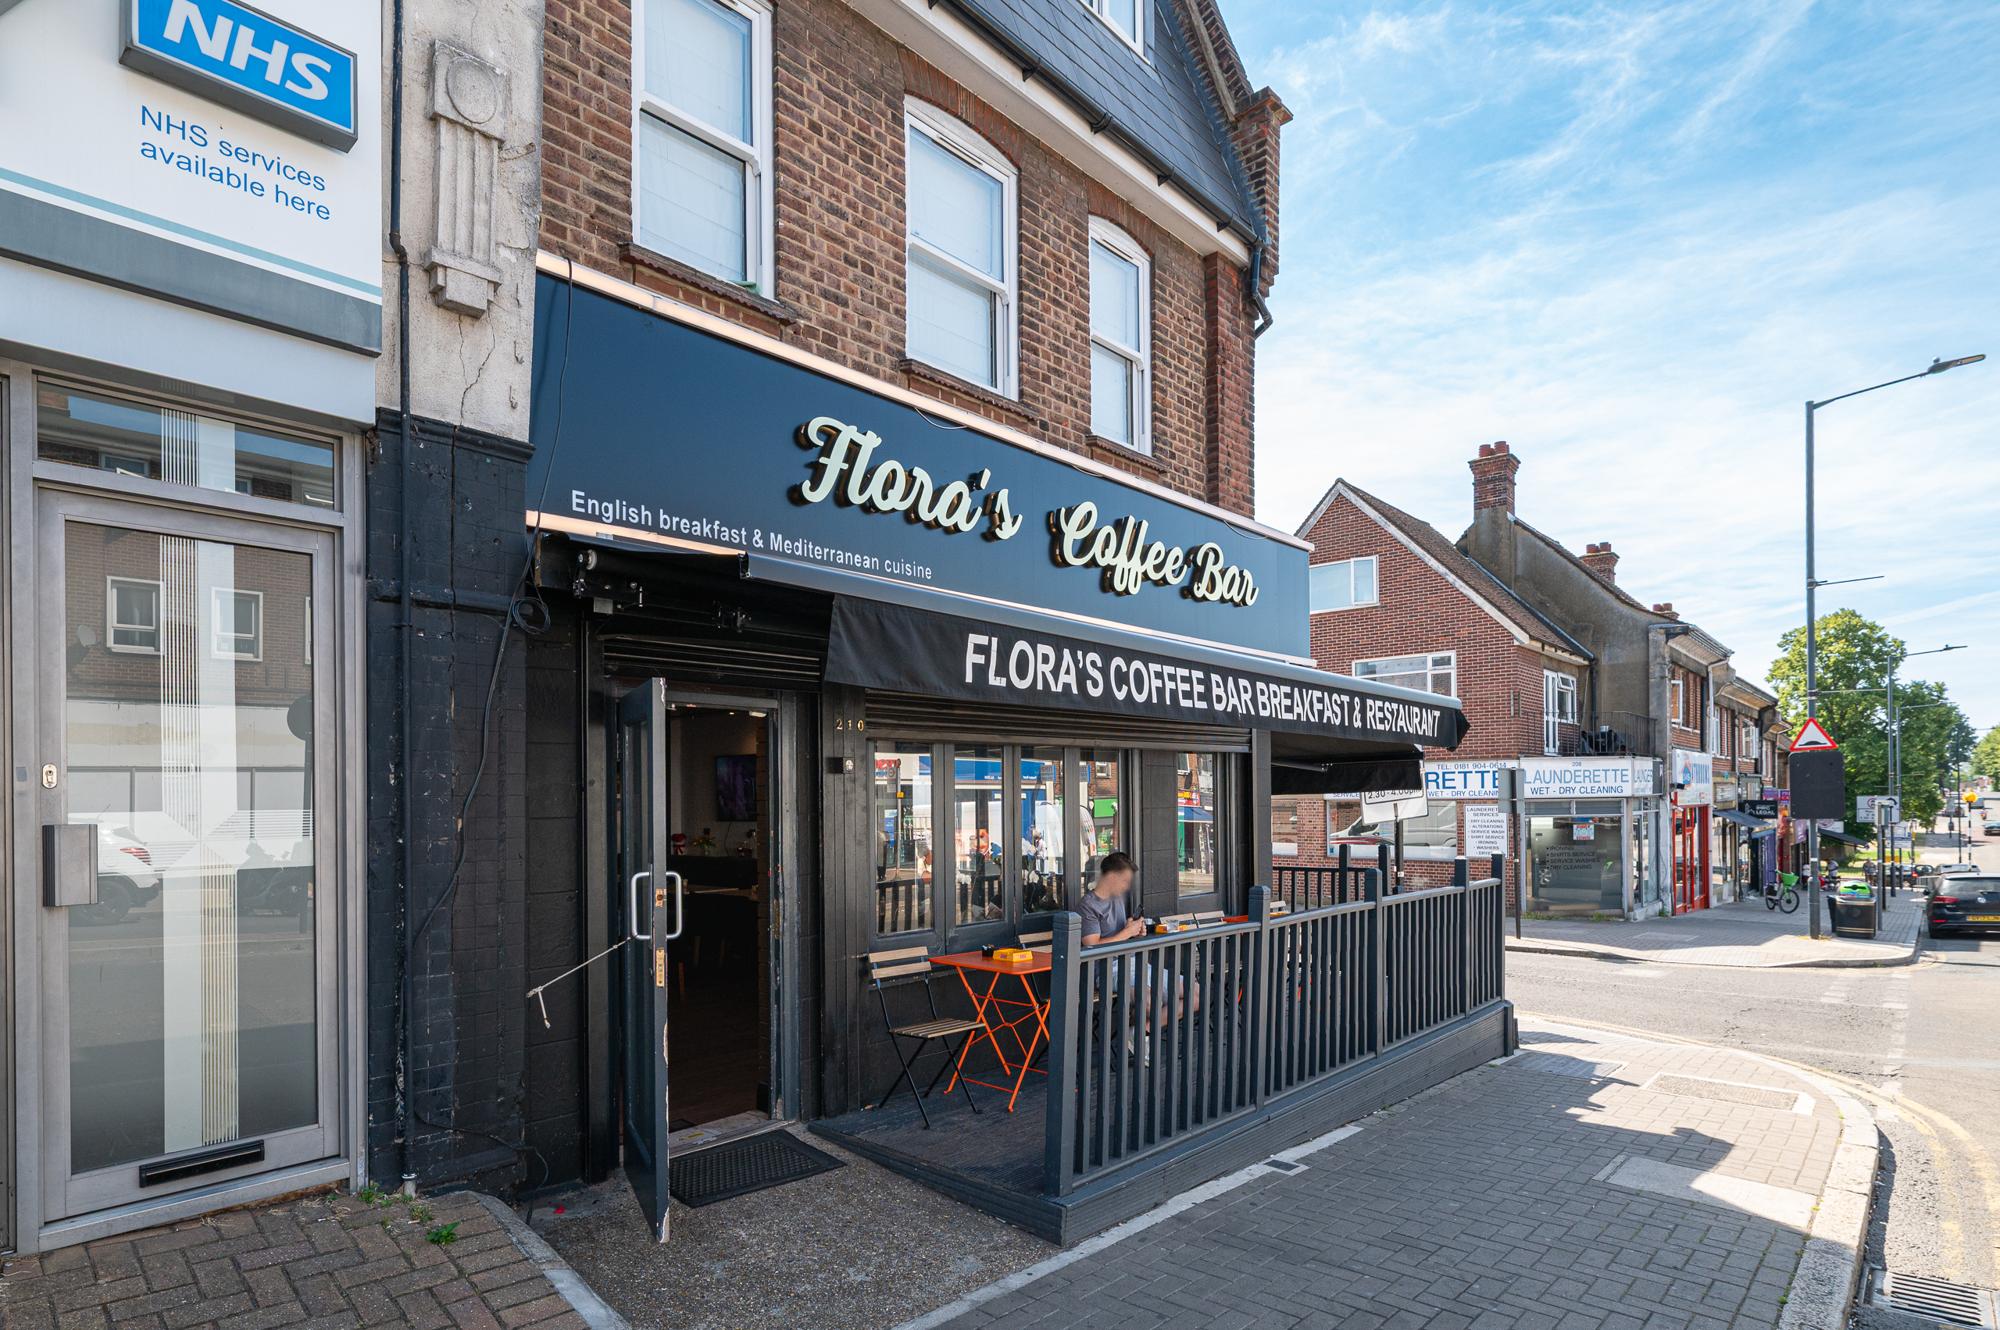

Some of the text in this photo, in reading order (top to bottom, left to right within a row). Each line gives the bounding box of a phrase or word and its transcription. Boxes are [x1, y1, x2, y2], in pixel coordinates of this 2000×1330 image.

[163, 0, 331, 101] NHS
[140, 141, 330, 221] available here
[141, 105, 326, 191] NHS services
[571, 489, 932, 580] English breakfast & Mediterranean cuisine
[802, 415, 1259, 606] Flora's Coffee Bar
[836, 719, 865, 732] 210
[965, 633, 1441, 738] FLORA'S COFFEE BAR BREAKFAST & RESTAURANT
[1524, 768, 1630, 784] LAUNDERETTE
[1530, 786, 1550, 795] WET
[1559, 786, 1576, 794] DRY
[1579, 785, 1624, 794] CLEANING
